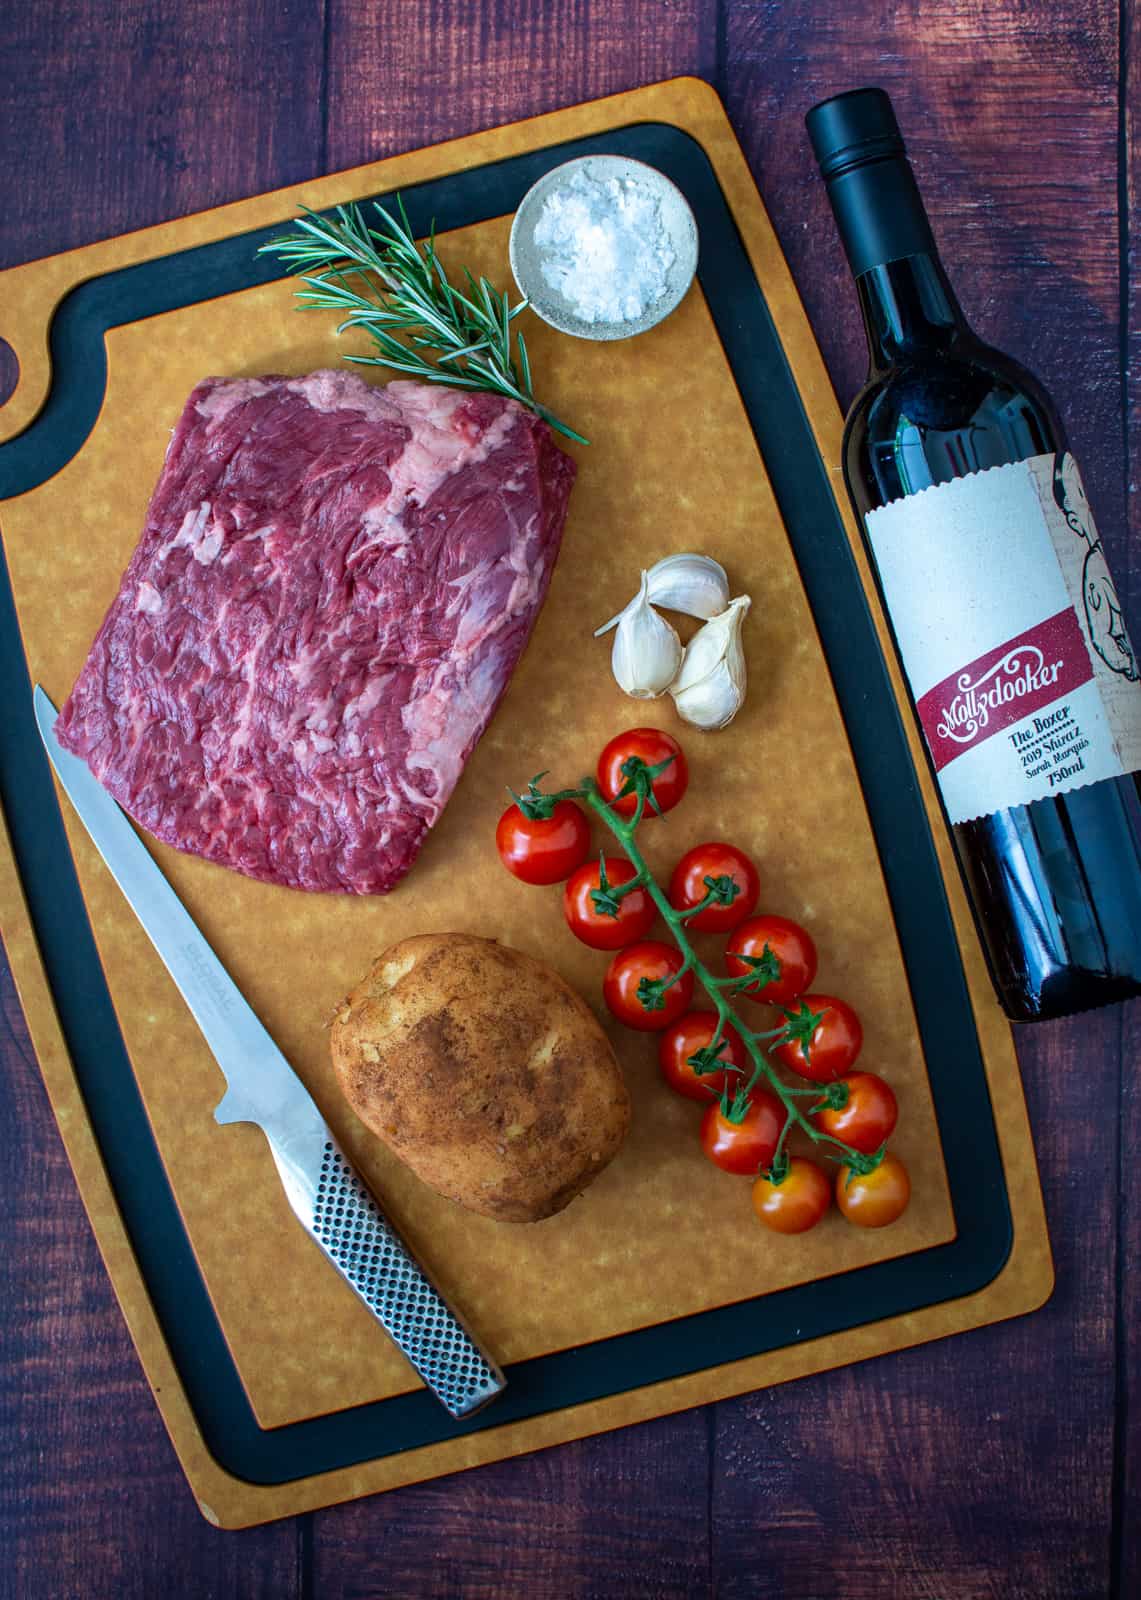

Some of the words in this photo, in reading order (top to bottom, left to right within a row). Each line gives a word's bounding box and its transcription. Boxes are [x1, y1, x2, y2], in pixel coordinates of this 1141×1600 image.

[937, 645, 1064, 743] Mollydooker
[1008, 731, 1034, 748] The
[1033, 705, 1070, 734] Boxer
[1020, 748, 1042, 767] 2019
[1043, 726, 1082, 754] Shiraz
[1025, 760, 1052, 779] Sarah
[1053, 738, 1090, 764] Marquis
[1046, 757, 1085, 787] 750ml
